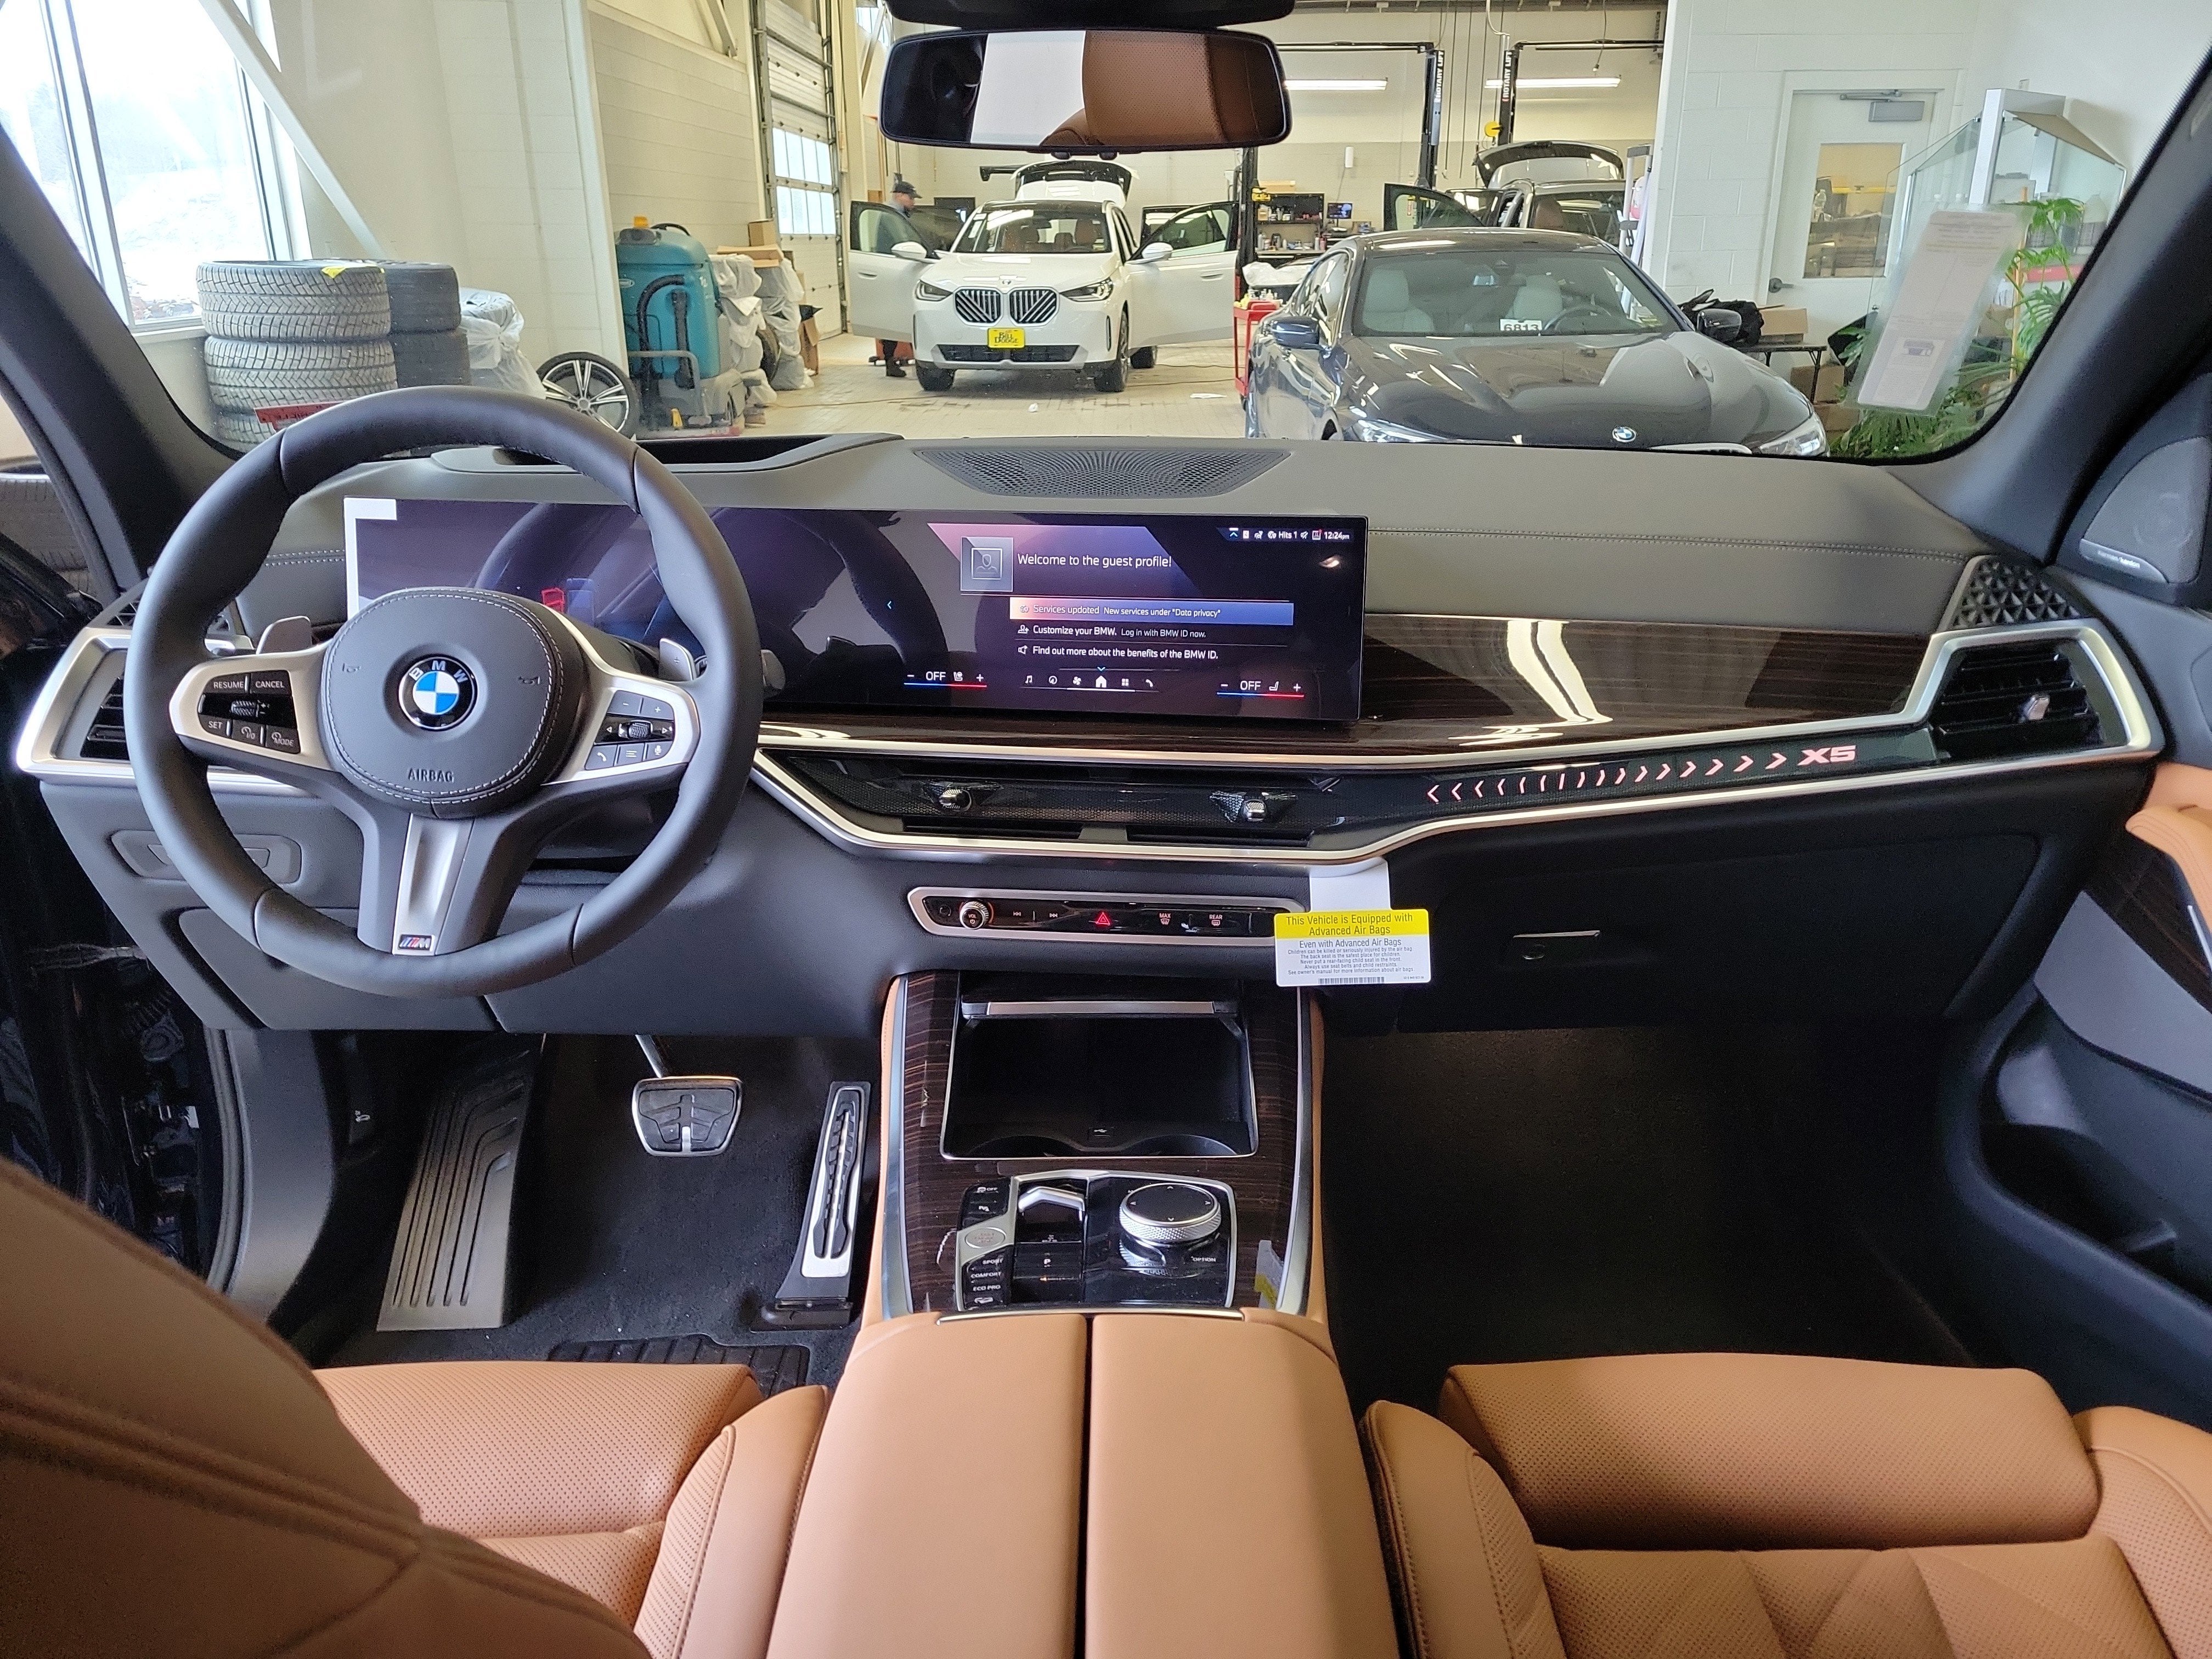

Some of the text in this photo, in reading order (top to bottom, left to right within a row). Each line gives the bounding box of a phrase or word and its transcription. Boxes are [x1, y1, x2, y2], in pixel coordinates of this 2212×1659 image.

[1324, 532, 1350, 540] 12:24pm
[1018, 553, 1172, 568] Welcome to the guest profile!
[1033, 605, 1099, 615] Services updated
[1150, 608, 1171, 616] under
[1172, 608, 1192, 617] "Data
[1193, 609, 1221, 618] privacy"
[1033, 625, 1117, 636] Customize your BMW.
[1121, 628, 1134, 637] Log
[1136, 628, 1142, 636] in
[1144, 629, 1158, 637] with
[1160, 629, 1179, 637] BMW
[1181, 629, 1188, 637] ID
[1032, 646, 1050, 655] Find
[1052, 647, 1065, 656] out
[1088, 647, 1111, 657] about
[1113, 648, 1125, 657] the
[1127, 648, 1158, 658] benefits
[1160, 649, 1169, 658] of
[1170, 649, 1182, 658] the
[1184, 650, 1206, 659] BMW
[1207, 650, 1218, 659] ID.
[409, 660, 468, 683] BMW
[926, 671, 946, 681] OFF
[255, 680, 284, 689] CANCEL
[1239, 680, 1261, 691] OFF
[208, 721, 223, 729] SET
[275, 737, 294, 747] MODE
[1797, 745, 1857, 766] X5
[408, 768, 454, 783] AIRBAG
[1286, 913, 1413, 926] This Vehicle is Equipped with
[1309, 925, 1391, 936] Advanced Air Bags
[1335, 939, 1369, 947] Advanced
[1372, 938, 1383, 946] Air
[1384, 938, 1402, 947] Bags
